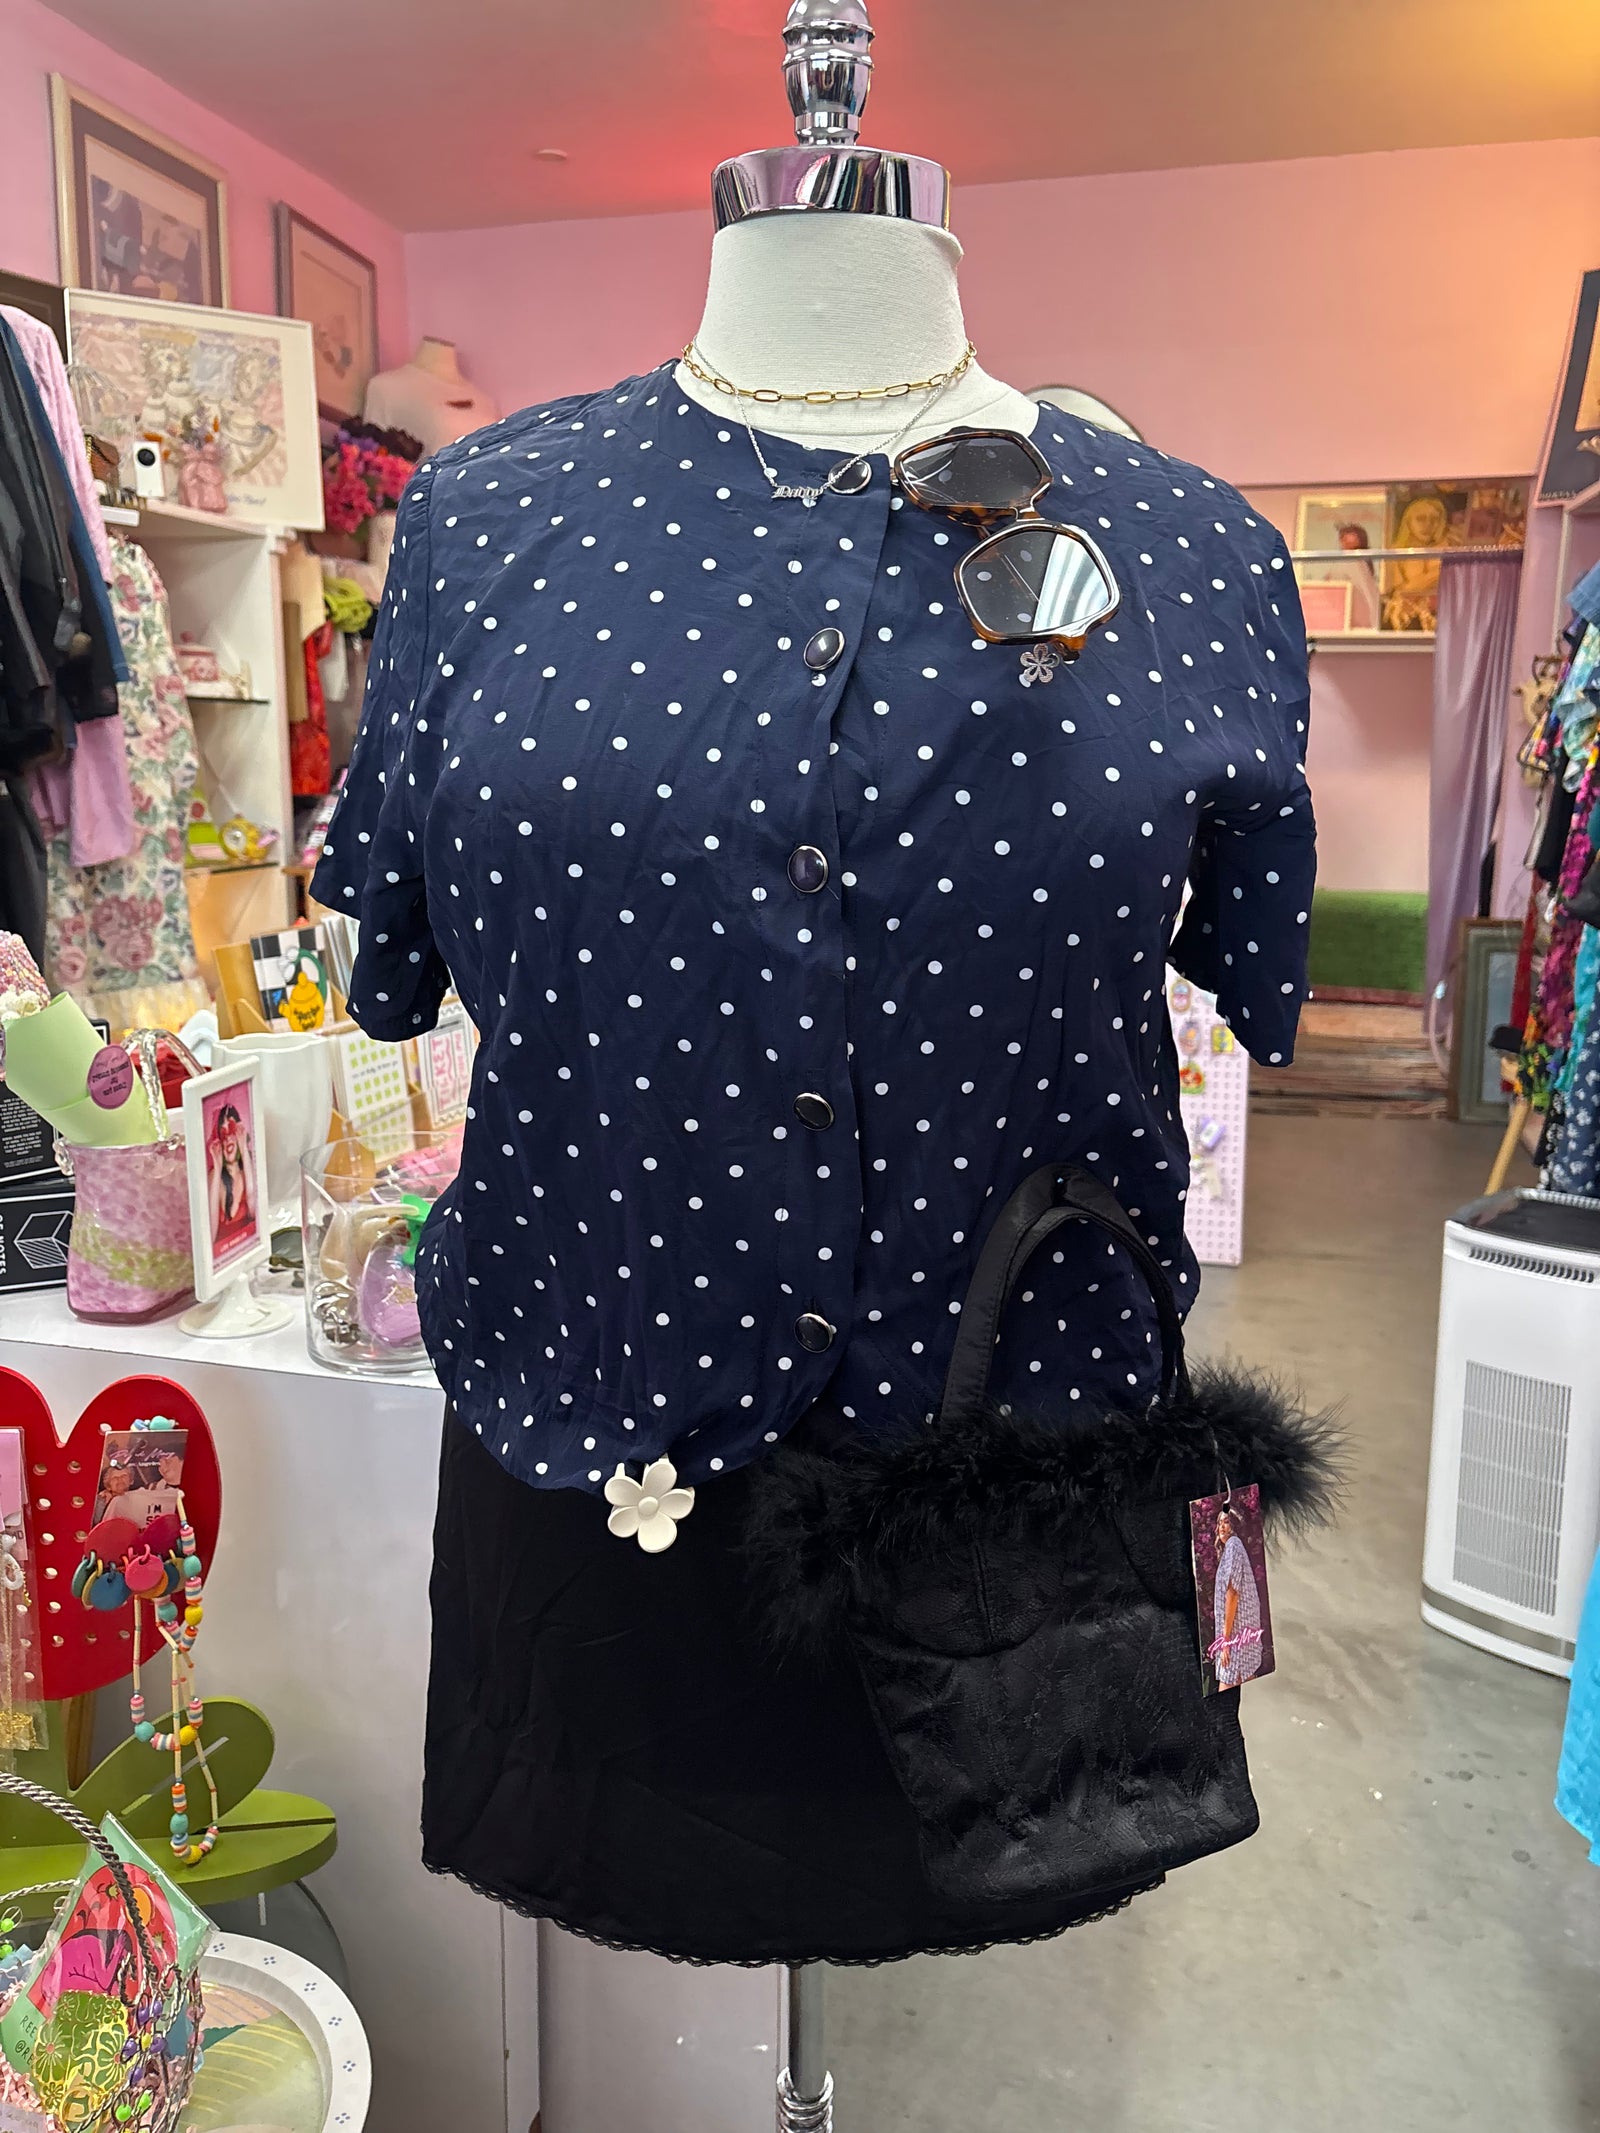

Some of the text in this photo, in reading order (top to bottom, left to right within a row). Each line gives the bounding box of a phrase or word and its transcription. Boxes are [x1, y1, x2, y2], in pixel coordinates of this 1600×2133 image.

[771, 485, 824, 501] Daddy
[145, 1514, 161, 1525] S
[1207, 1627, 1265, 1660] Proud Mary
